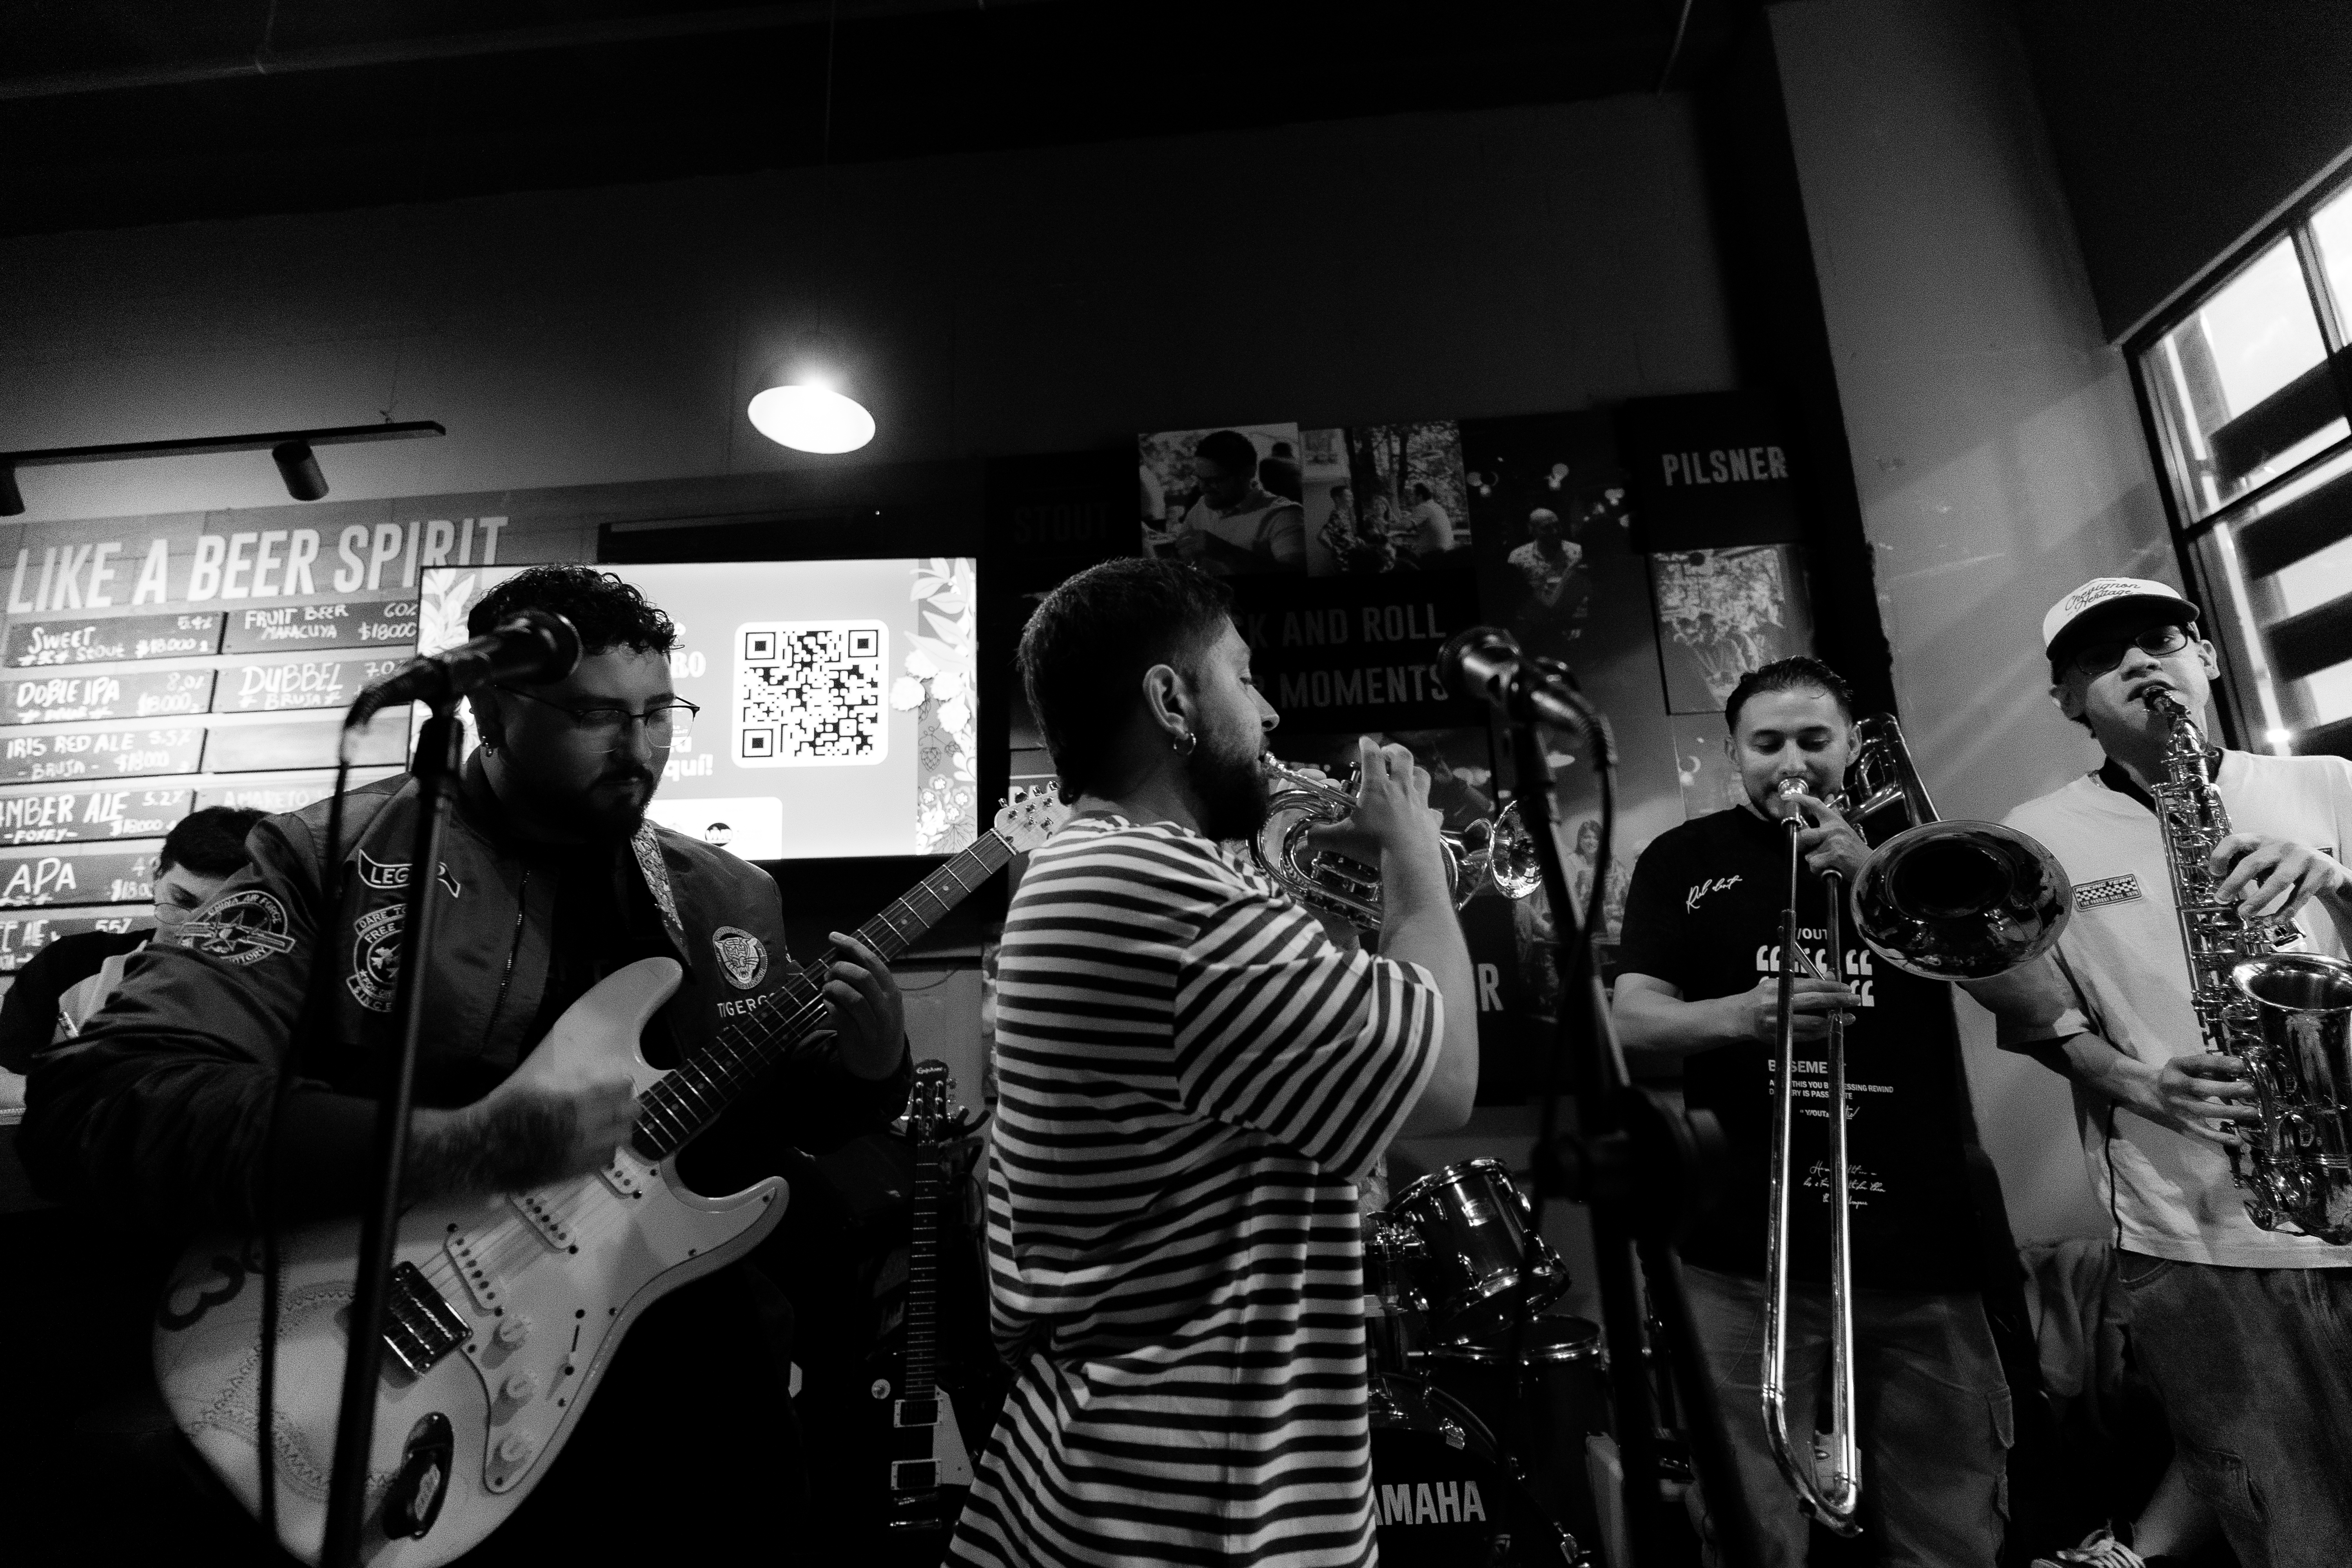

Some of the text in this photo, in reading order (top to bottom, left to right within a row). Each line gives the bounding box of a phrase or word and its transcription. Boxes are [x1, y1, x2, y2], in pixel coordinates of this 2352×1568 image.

[1662, 446, 1789, 486] PILSNER
[7, 516, 509, 614] LIKE A BEER SPIRIT
[245, 608, 298, 629] FRUIT
[1282, 609, 1348, 647] AND
[1363, 603, 1446, 643] ROLL
[17, 677, 119, 707] DOBLE IPA
[239, 662, 343, 695] DUBBEL
[1279, 664, 1449, 709] MOMENTS
[7, 731, 136, 759] IRIS RED ALE
[0, 791, 131, 828] MBER ALE
[3, 857, 77, 896] APA
[2076, 877, 2132, 892] RACING TEAM
[359, 909, 387, 928] DARE
[365, 922, 396, 943] FREE
[1868, 1085, 1894, 1093] REWIND
